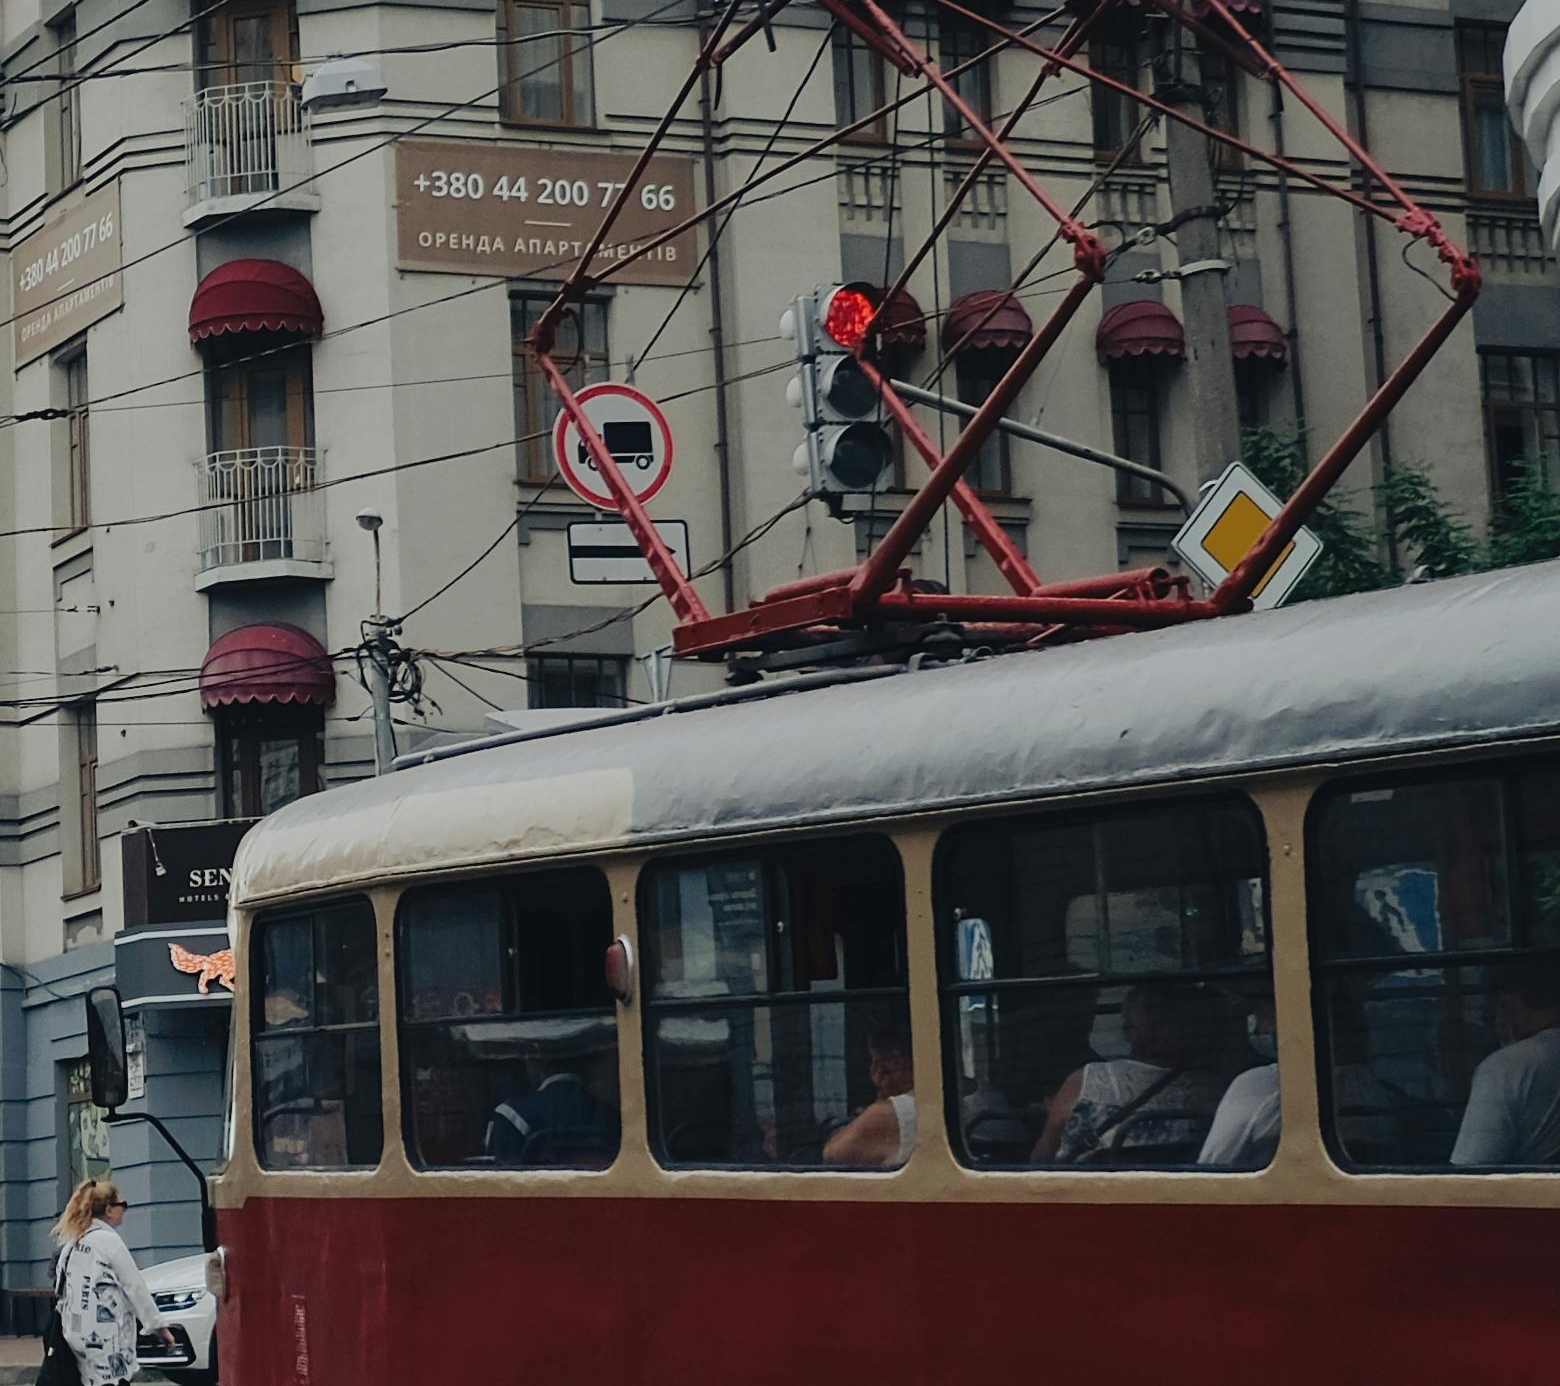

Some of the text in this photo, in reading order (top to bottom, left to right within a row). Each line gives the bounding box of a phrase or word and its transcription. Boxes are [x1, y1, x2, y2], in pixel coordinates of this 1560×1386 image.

[414, 170, 484, 200] +380
[492, 175, 528, 203] 44
[537, 178, 589, 207] 200
[641, 184, 675, 211] 66
[19, 212, 113, 292] +380 44 200 77 66
[418, 231, 505, 254] ОРЕНДА
[21, 314, 52, 342] ОРЕНДА
[178, 894, 219, 903] HOTELS
